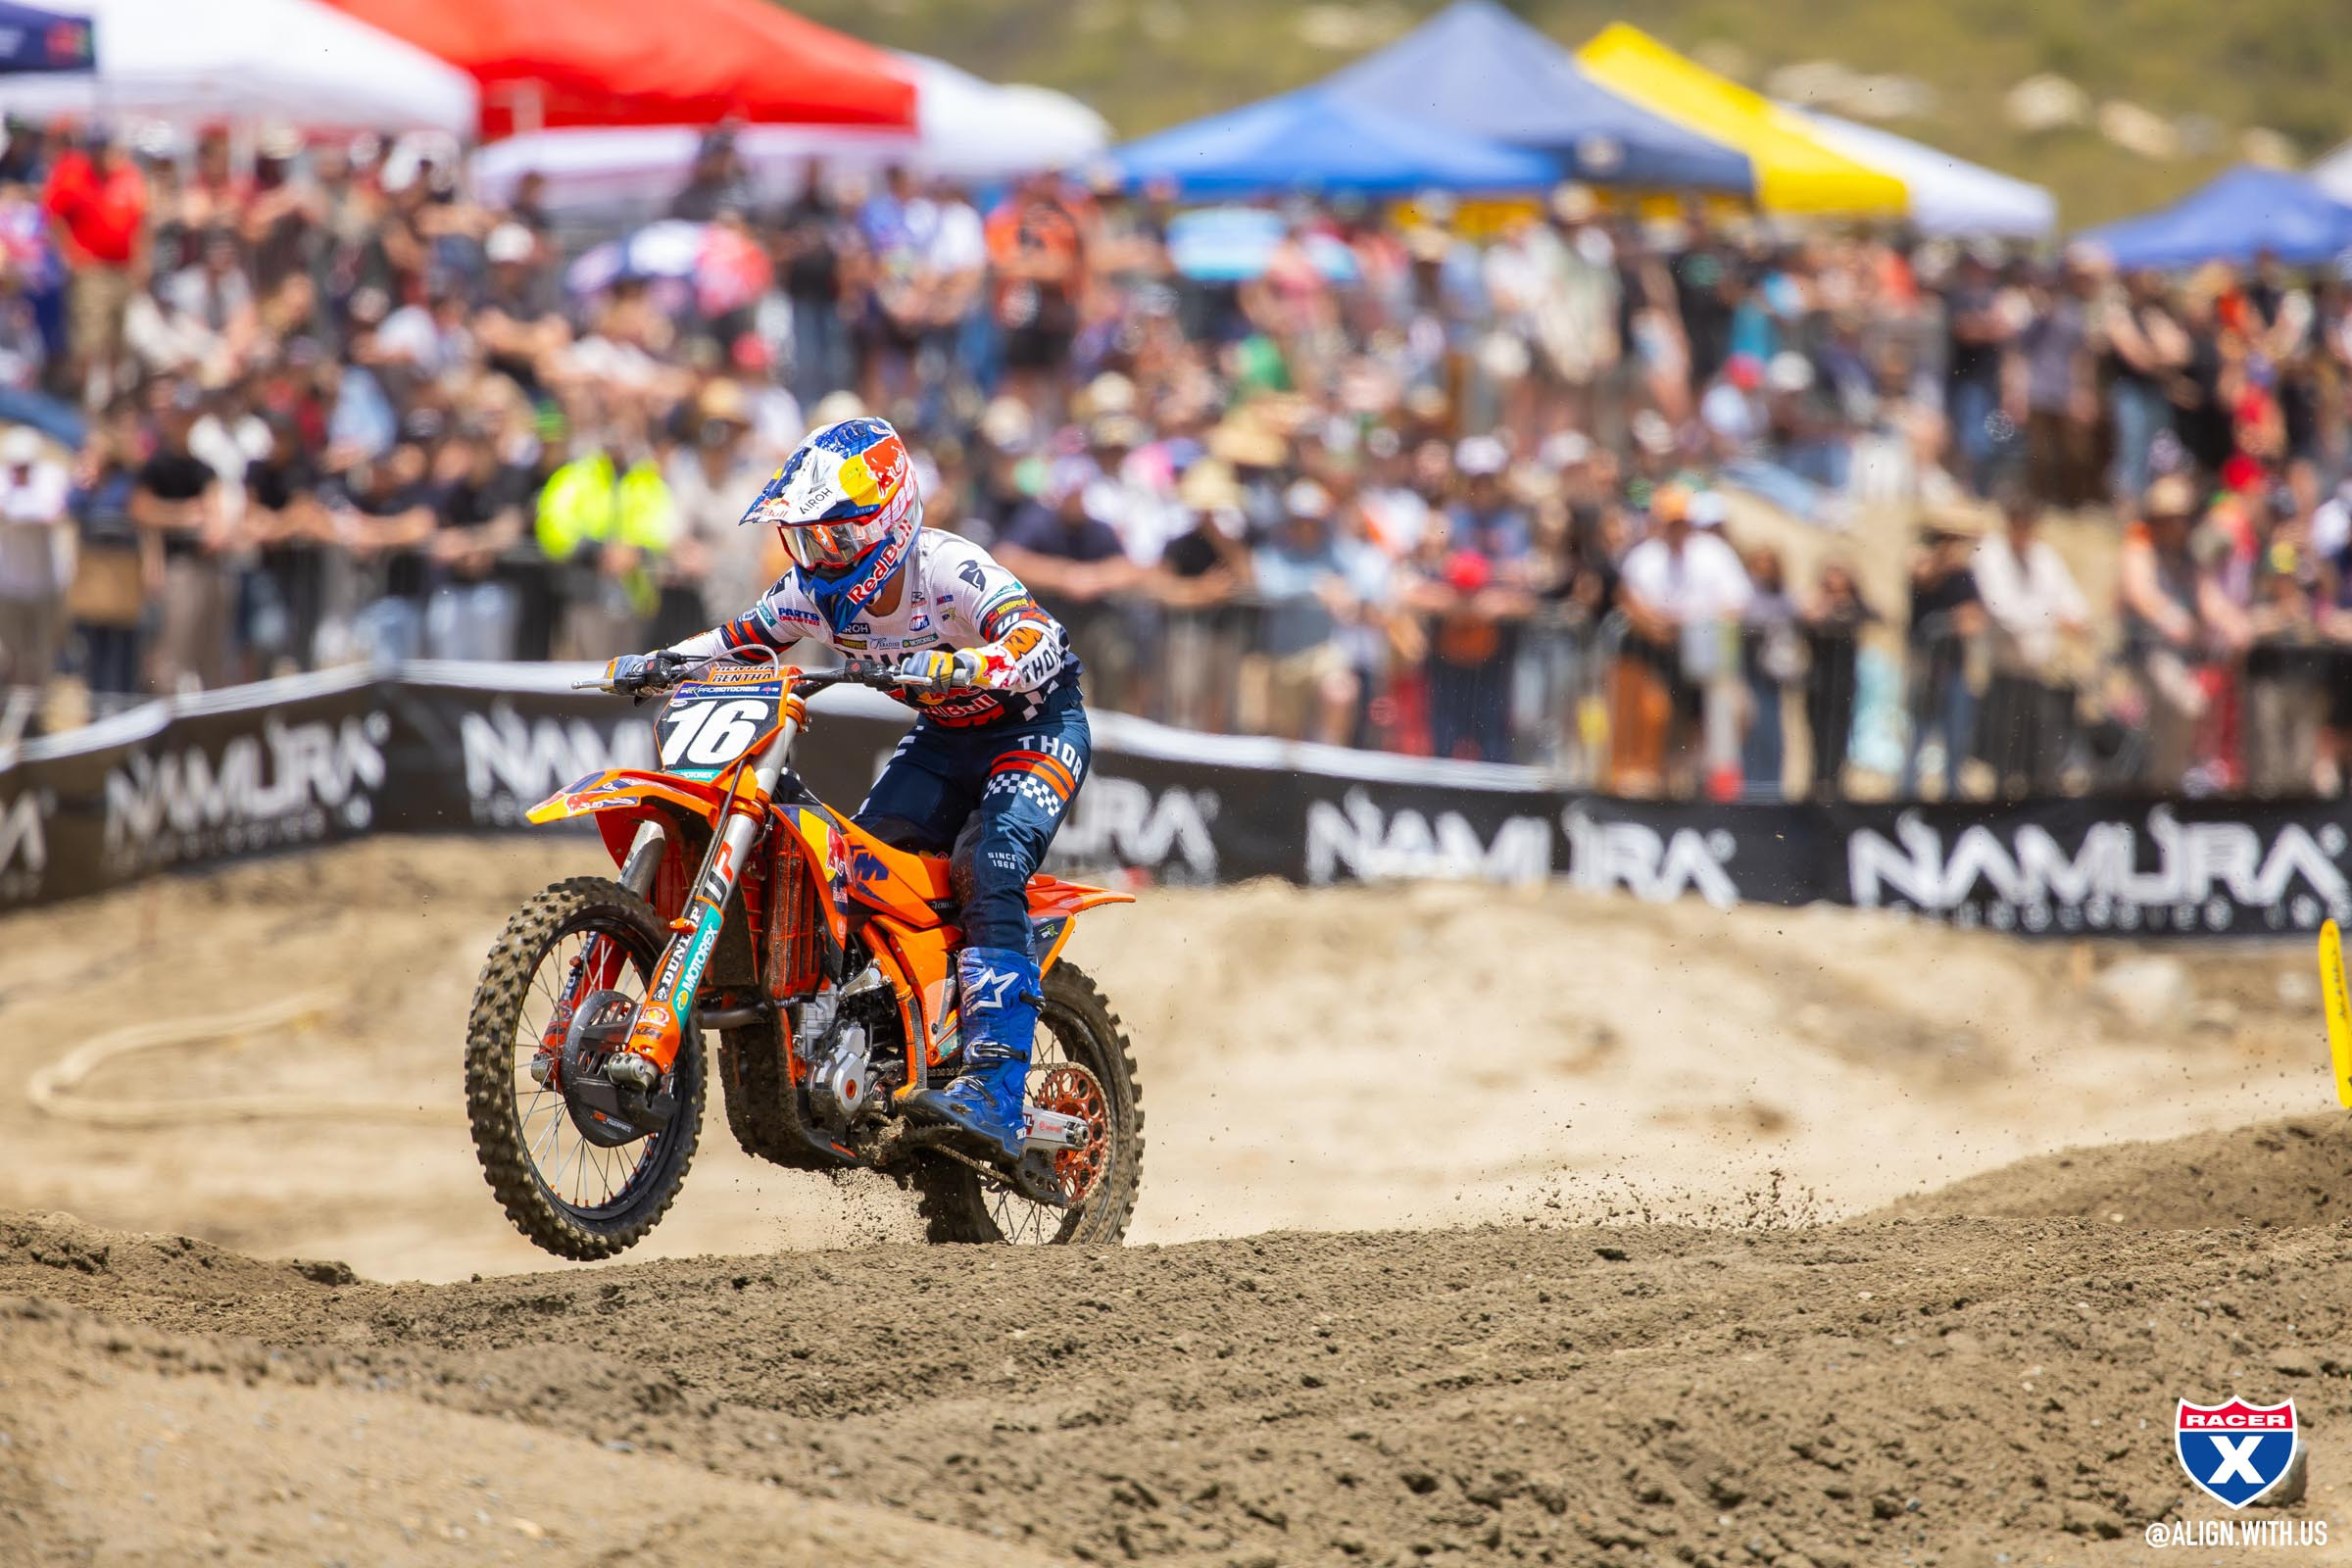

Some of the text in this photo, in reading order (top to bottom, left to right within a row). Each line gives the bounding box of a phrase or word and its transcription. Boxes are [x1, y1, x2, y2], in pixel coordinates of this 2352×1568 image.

[799, 487, 833, 514] AIROH
[847, 518, 913, 605] Red Bull
[778, 607, 820, 621] PARTS
[711, 673, 774, 683] RENTHA
[944, 693, 999, 718] Bull
[663, 700, 769, 764] 16
[1017, 735, 1083, 784] THOR
[987, 852, 1016, 861] SINCE
[993, 859, 1015, 869] 1968
[1847, 804, 2351, 923] NAMURA
[682, 922, 718, 992] MOTOREX
